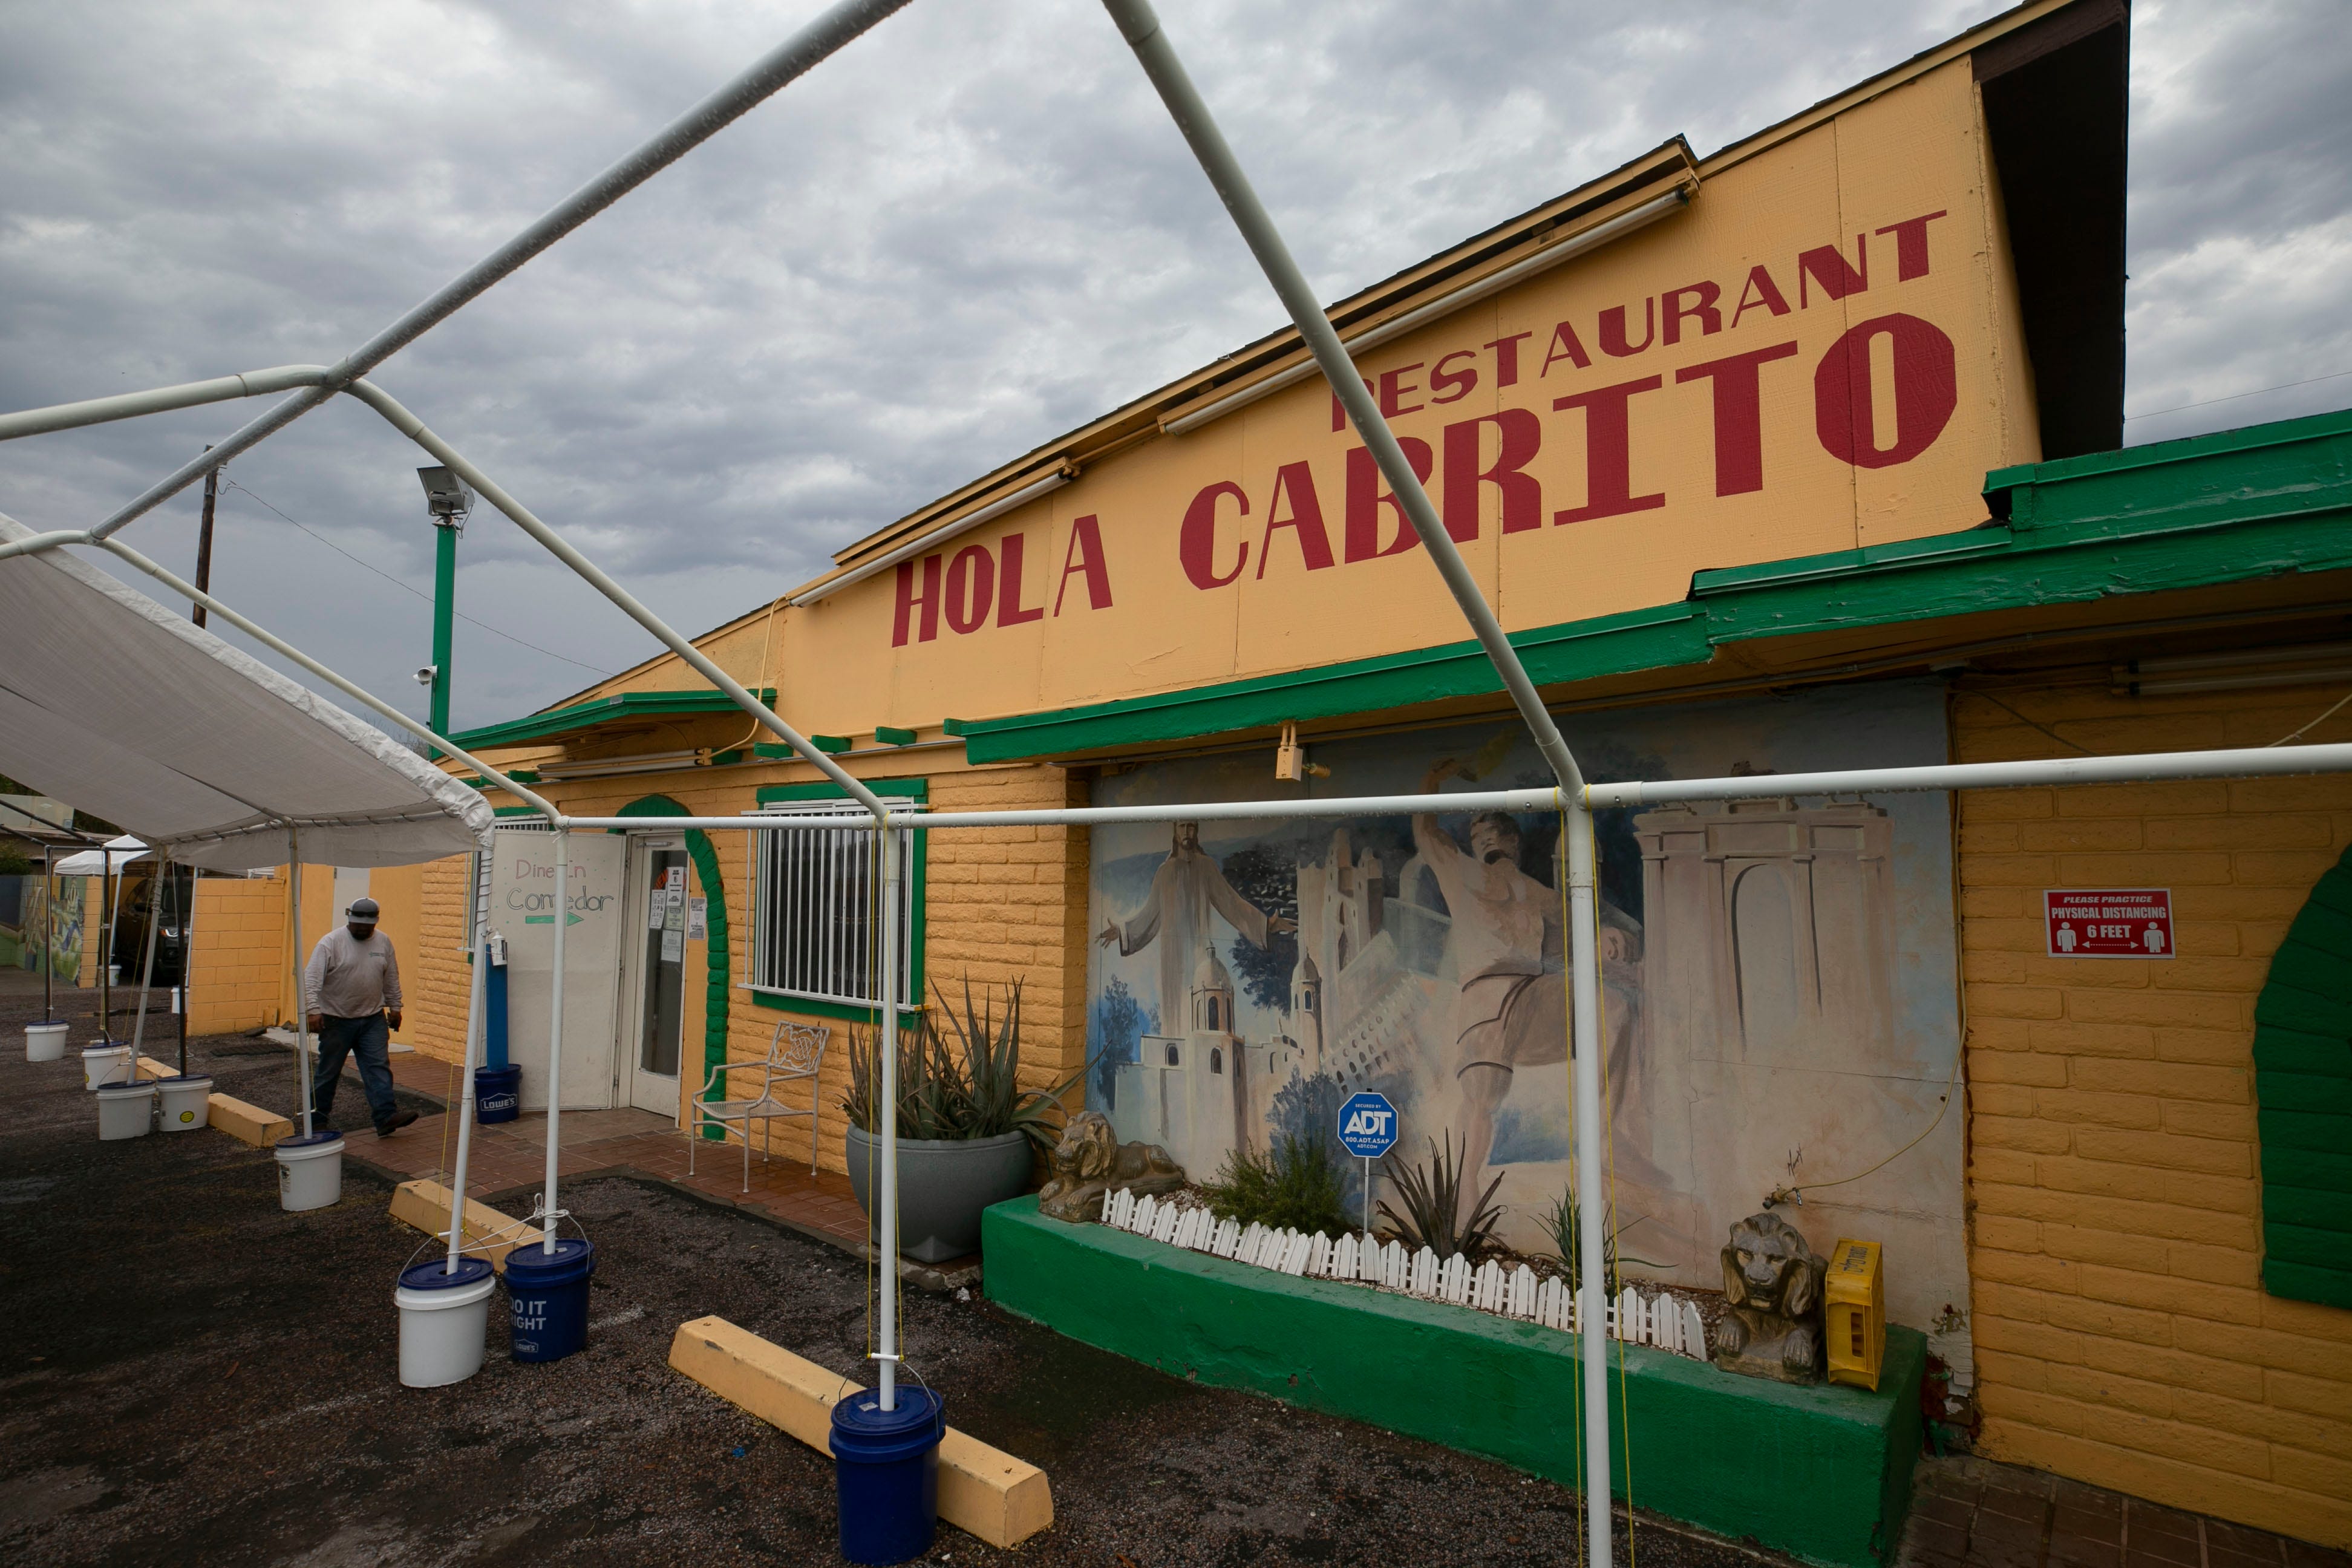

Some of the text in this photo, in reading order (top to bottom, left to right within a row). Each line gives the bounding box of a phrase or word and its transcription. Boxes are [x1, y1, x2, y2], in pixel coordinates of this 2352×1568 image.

[892, 313, 1957, 648] HOLA CABRITO
[515, 859, 555, 880] Dine
[2051, 907, 2166, 919] PHYSICAL DISTANCING
[2086, 924, 2131, 938] 6 FEET
[483, 1097, 515, 1109] LOWE'S
[1344, 1111, 1392, 1135] ADT
[529, 1301, 547, 1315] IT
